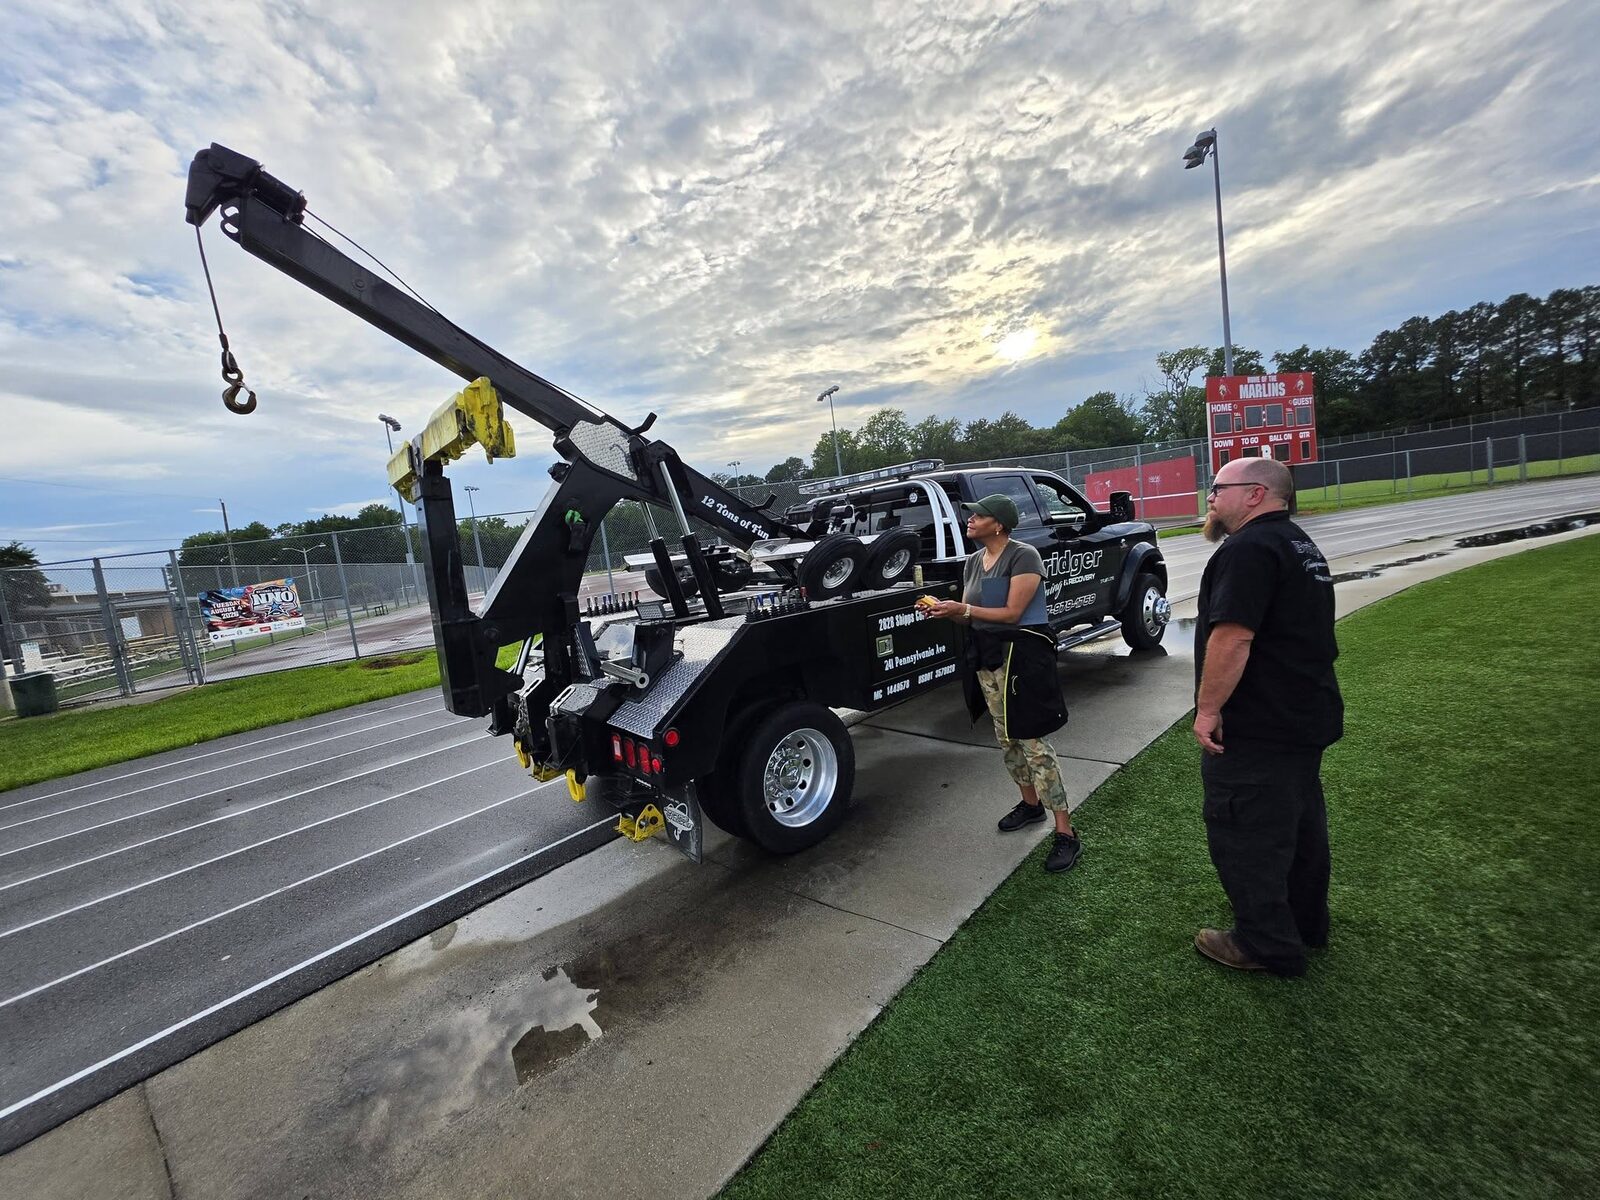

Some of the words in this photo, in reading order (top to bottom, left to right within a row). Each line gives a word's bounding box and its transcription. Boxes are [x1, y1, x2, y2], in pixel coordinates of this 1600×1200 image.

[1239, 382, 1286, 399] MARLINS
[1292, 397, 1313, 406] GUEST
[1211, 403, 1233, 413] HOME
[1214, 439, 1234, 448] DOWN
[701, 495, 715, 508] 12
[716, 503, 740, 523] Tons
[740, 519, 752, 529] of
[751, 523, 770, 540] Fun
[1068, 573, 1096, 585] RECOVERY
[252, 590, 294, 605] NNO
[210, 606, 236, 615] AUGUST
[212, 600, 241, 609] TUESDAY
[895, 612, 915, 627] Shipps
[894, 647, 935, 667] Pennsylvania
[935, 643, 946, 654] Ave
[917, 671, 934, 684] USDOT
